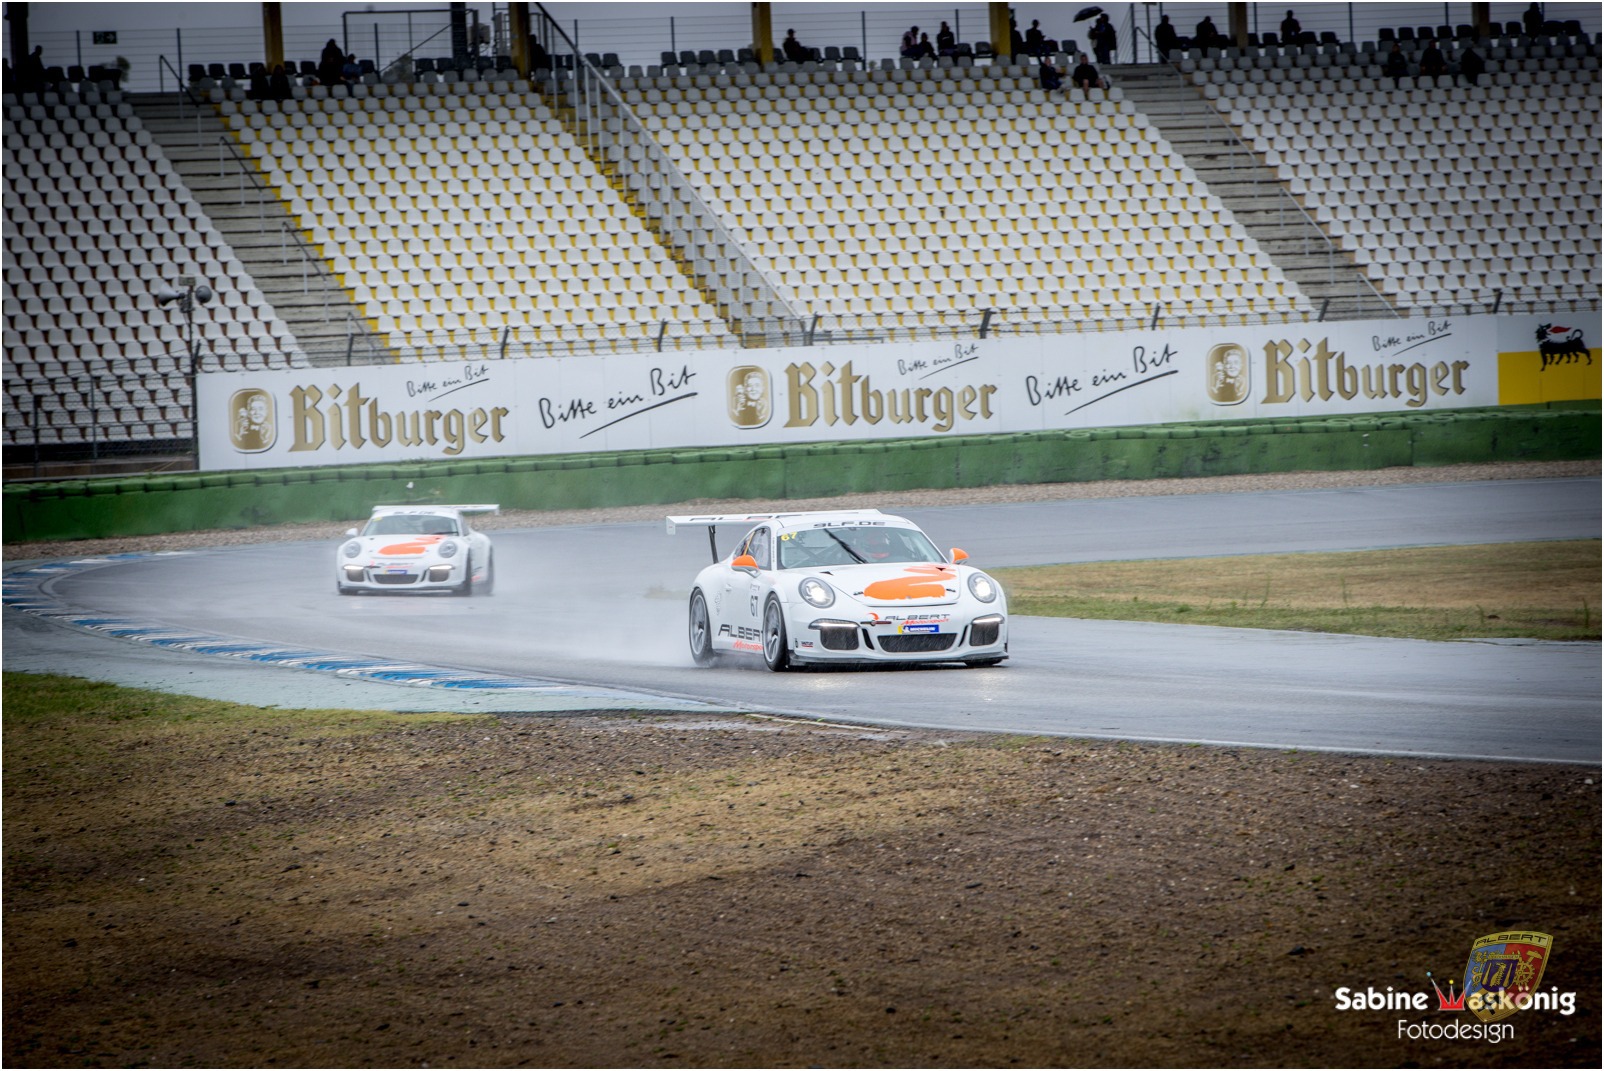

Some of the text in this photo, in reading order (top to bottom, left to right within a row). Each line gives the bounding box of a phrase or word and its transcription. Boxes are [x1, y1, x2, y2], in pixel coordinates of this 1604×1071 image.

[897, 343, 979, 375] Bitte ein Bit
[1372, 321, 1452, 352] Bitte ein Bit
[407, 365, 489, 397] Bitte ein Bit
[1026, 343, 1178, 406] Bitte ein Bit
[1261, 337, 1470, 407] Bitburger
[289, 382, 509, 455] Bitburger
[539, 365, 696, 429] Bitte ein Bit
[783, 360, 998, 432] Bitburger
[781, 531, 798, 541] 67
[718, 624, 763, 641] ALBER
